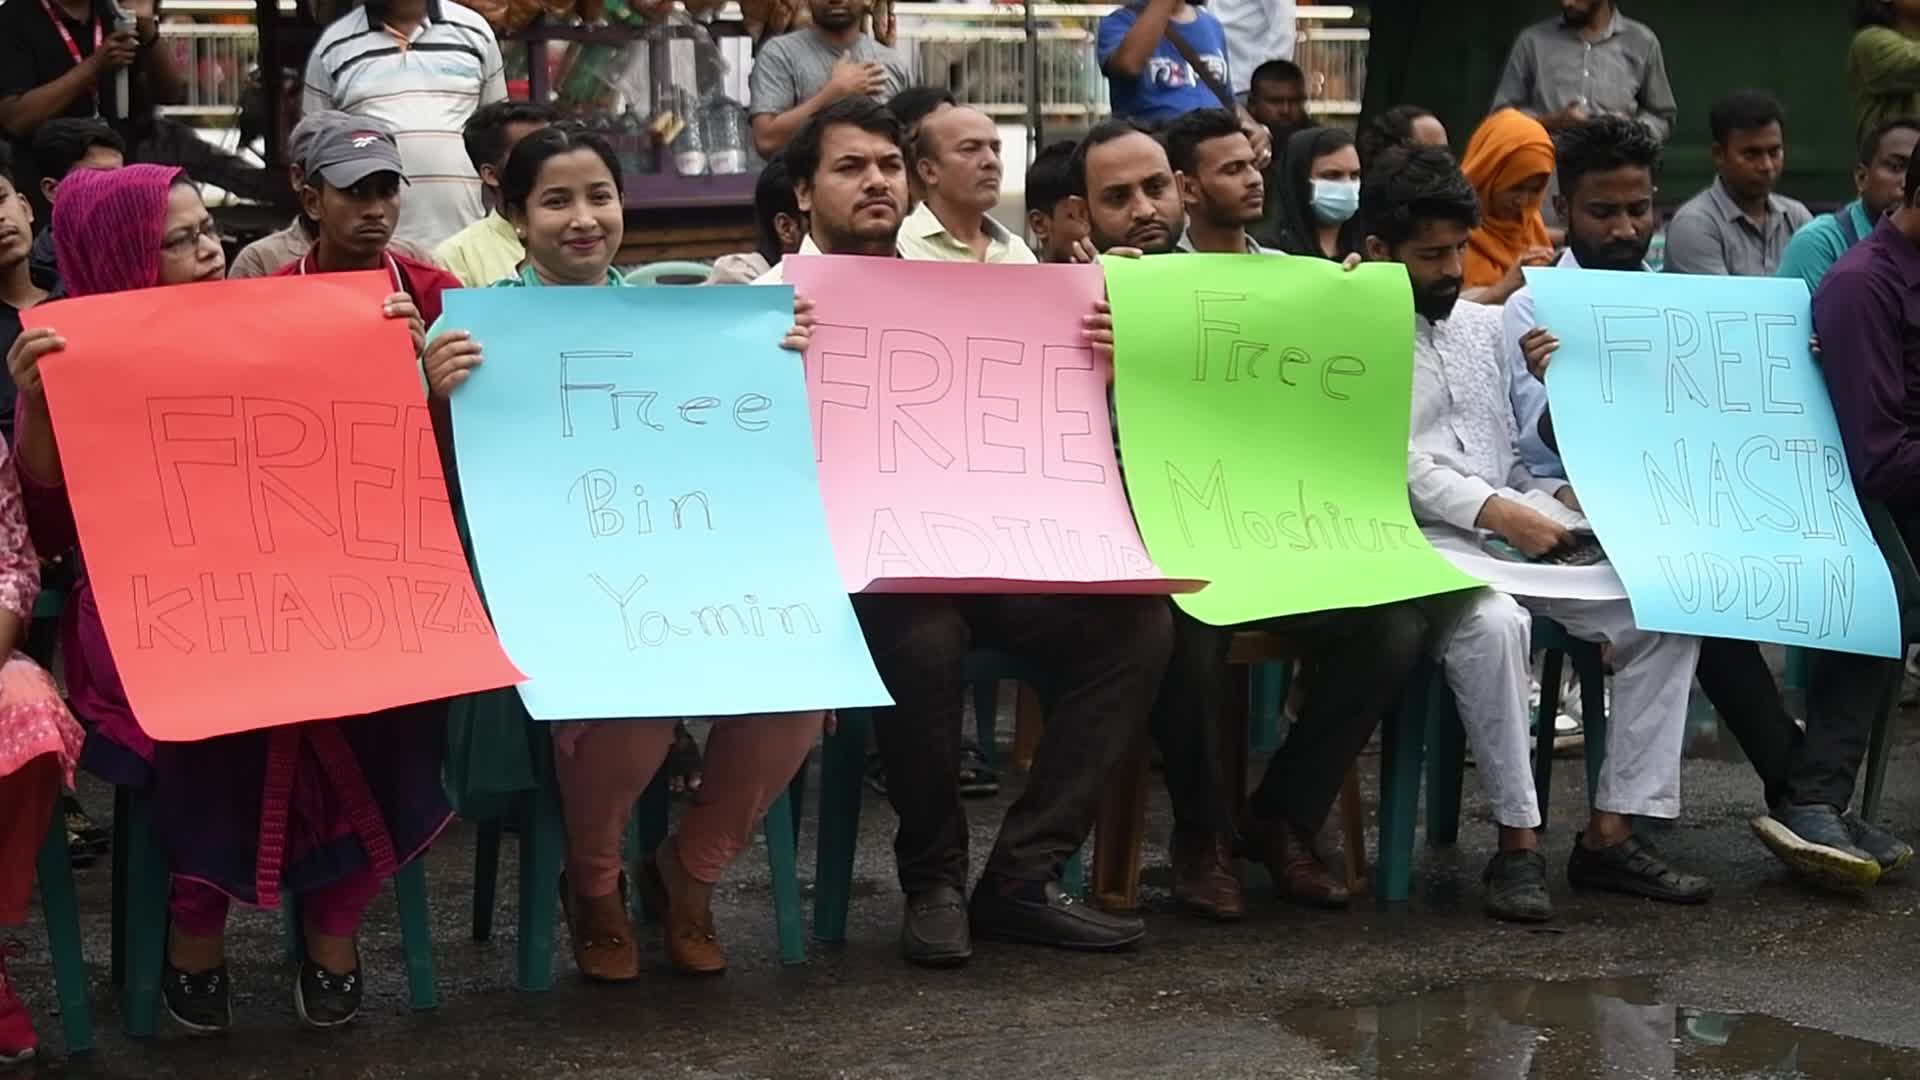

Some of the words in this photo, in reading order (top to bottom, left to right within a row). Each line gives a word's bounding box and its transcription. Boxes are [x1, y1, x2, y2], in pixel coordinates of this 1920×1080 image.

[560, 350, 773, 438] Free
[1191, 290, 1366, 401] Free
[1592, 305, 1804, 414] FREE
[815, 323, 1106, 484] FREE
[146, 395, 472, 573] FREE
[568, 469, 714, 538] Bin
[1643, 435, 1876, 547] NASIR
[131, 572, 491, 655] KHADIZA
[590, 571, 822, 652] Yamin
[1658, 552, 1856, 640] UDDIN
